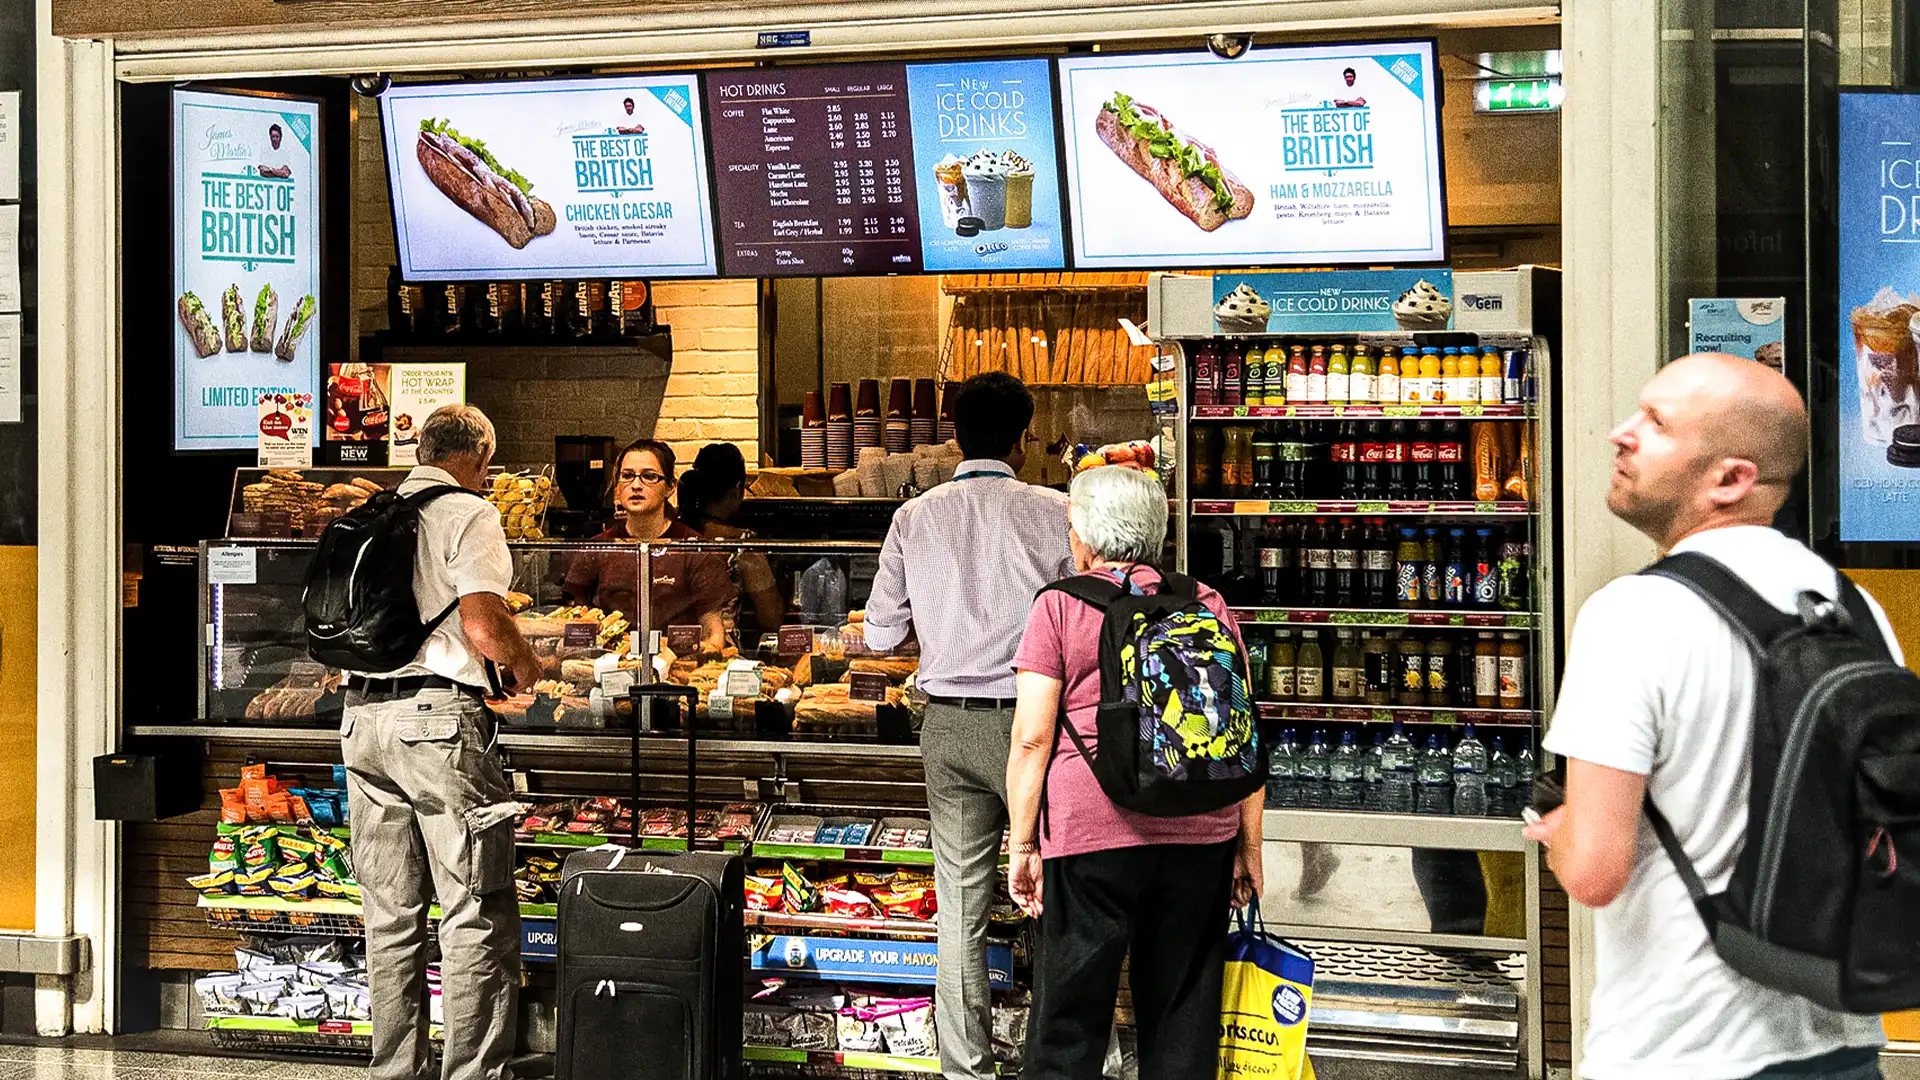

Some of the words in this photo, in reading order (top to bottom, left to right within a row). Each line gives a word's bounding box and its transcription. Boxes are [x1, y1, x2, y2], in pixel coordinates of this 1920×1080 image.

[719, 84, 745, 97] HOT
[747, 83, 786, 96] DRINKS
[960, 78, 989, 90] NEW
[936, 93, 965, 112] ICE
[970, 90, 1025, 111] COLD
[762, 116, 796, 126] Cappuccino
[938, 111, 1028, 138] DRINKS
[1281, 114, 1309, 134] THE
[1313, 112, 1350, 133] BEST
[1353, 112, 1371, 132] OF
[764, 135, 794, 143] Americano
[882, 130, 897, 138] 2.70
[572, 140, 598, 158] THE
[600, 139, 631, 158] BEST
[634, 138, 649, 157] OF
[1282, 133, 1374, 167] BRITISH
[728, 164, 760, 172] SPECIALITY
[833, 161, 848, 169] 2.95
[858, 160, 873, 168] 3.20
[884, 159, 900, 167] 3.50
[575, 158, 654, 188] BRITISH
[768, 172, 791, 180] Caramel
[834, 169, 849, 177] 2.95
[859, 169, 874, 177] 3.20
[885, 168, 901, 176] 3.50
[835, 178, 850, 187] 2.95
[860, 177, 875, 186] 3.20
[886, 177, 901, 185] 3.50
[201, 180, 232, 209] THE
[235, 182, 274, 212] BEST
[276, 184, 295, 213] OF
[861, 187, 875, 195] 2.95
[1270, 183, 1298, 199] HAM
[1301, 184, 1309, 198] &
[1312, 181, 1393, 198] MOZZARELLA
[770, 199, 782, 207] Hot
[782, 198, 810, 206] Chocolate
[862, 196, 876, 204] 2.95
[565, 203, 620, 222] CHICKEN
[623, 201, 673, 220] CAESAR
[734, 221, 745, 229] TEA
[772, 220, 794, 229] English
[794, 219, 819, 227] Breakfast
[201, 210, 296, 256] BRITISH
[737, 249, 758, 257] EXTRAS
[1319, 288, 1342, 296] NEW
[1272, 297, 1295, 312] ICE
[1297, 297, 1338, 312] COLD
[1341, 296, 1391, 311] DRINKS
[1475, 296, 1502, 310] Gem
[1695, 332, 1752, 345] Recruiting
[1695, 343, 1722, 352] now!
[401, 377, 422, 387] HOT
[425, 377, 455, 387] WRAP
[202, 387, 249, 407] LIMITED
[291, 427, 309, 435] WIN
[340, 449, 368, 459] NEW
[815, 948, 865, 964] UPGRADE
[870, 949, 899, 965] YOUR
